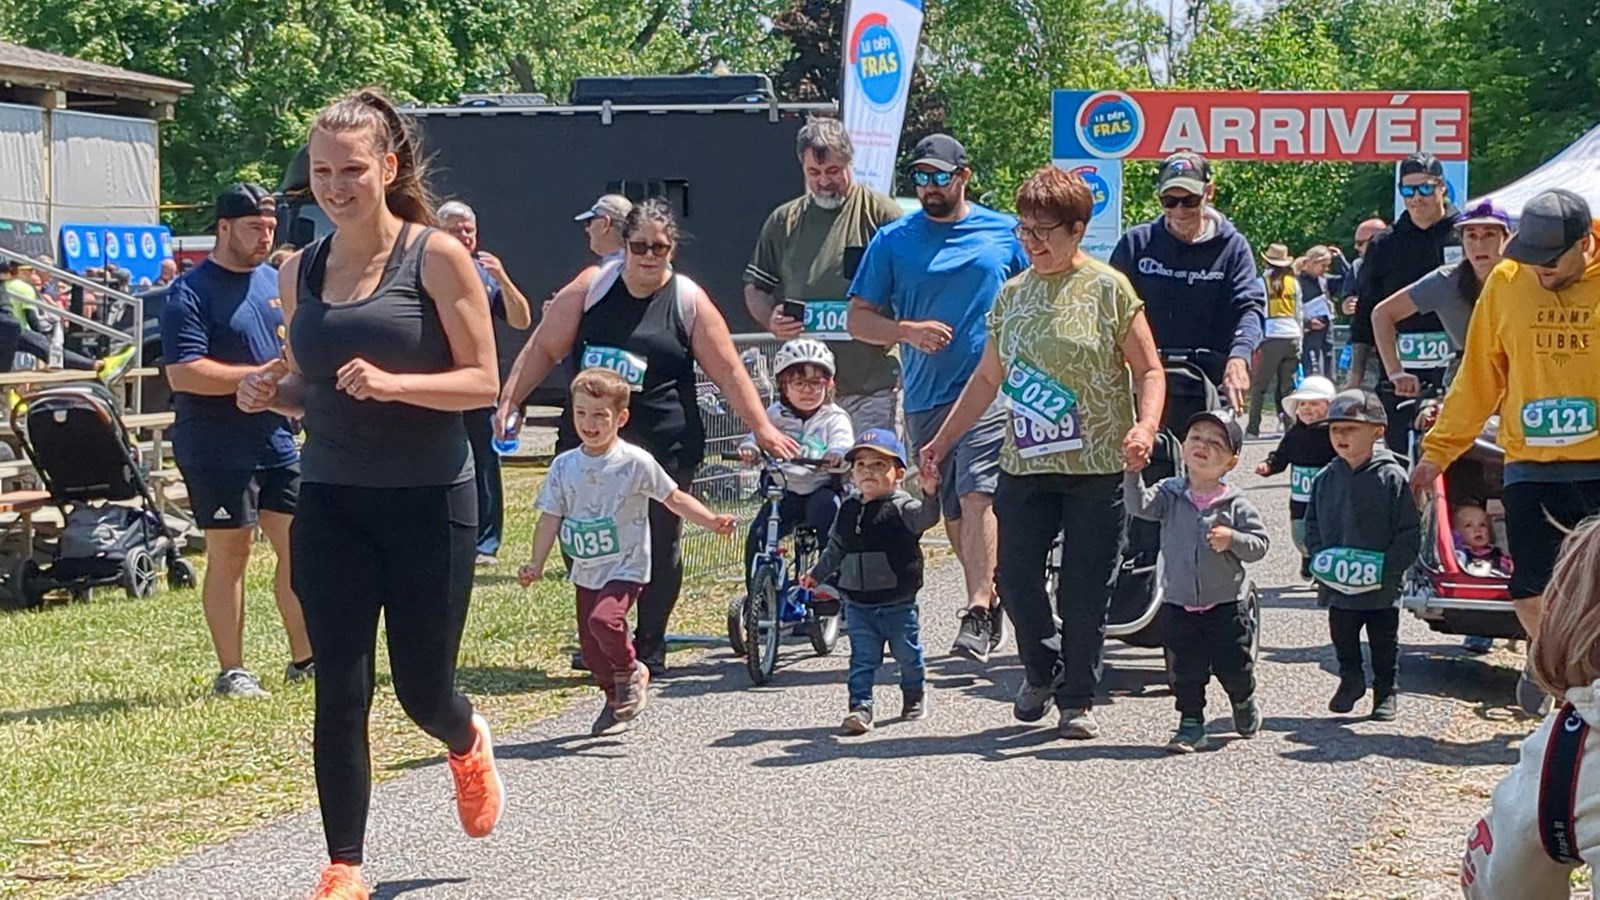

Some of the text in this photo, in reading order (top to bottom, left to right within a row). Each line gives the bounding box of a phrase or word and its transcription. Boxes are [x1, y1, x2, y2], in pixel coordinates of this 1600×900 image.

[861, 34, 891, 54] LE DÉFI
[859, 52, 899, 79] FRAS
[1092, 120, 1132, 138] FRAS
[1094, 110, 1126, 123] LE DÉFI
[1160, 94, 1463, 155] ARRIVÉE
[1138, 257, 1225, 285] Champion
[815, 310, 848, 331] 104
[1537, 310, 1590, 324] CHAMP
[1417, 340, 1449, 359] 120
[1536, 332, 1590, 349] LIBRE
[605, 357, 640, 383] 105
[1021, 382, 1066, 419] 012
[1547, 407, 1593, 435] 121
[573, 529, 614, 556] 035
[1334, 559, 1378, 586] 028
